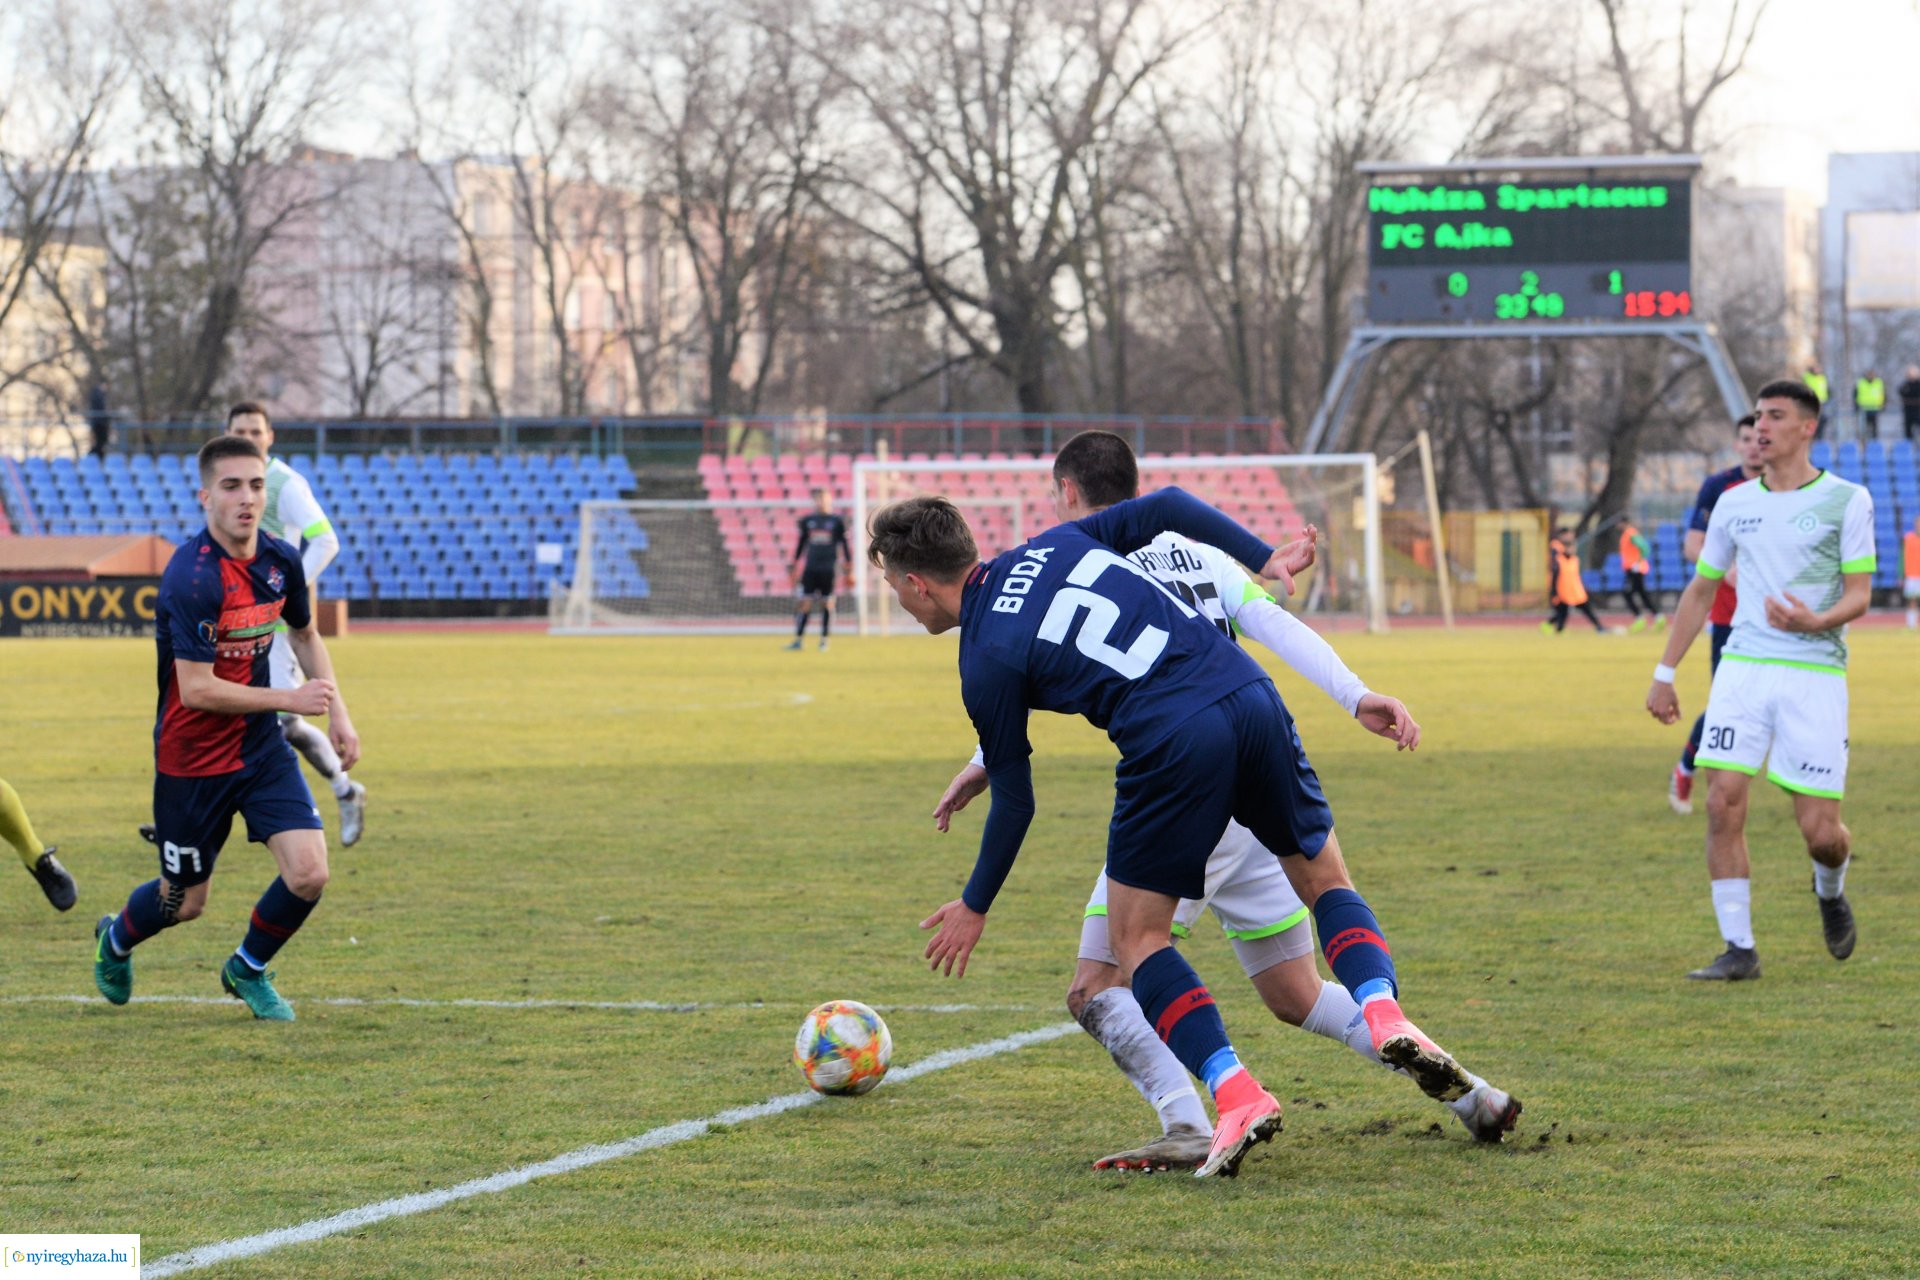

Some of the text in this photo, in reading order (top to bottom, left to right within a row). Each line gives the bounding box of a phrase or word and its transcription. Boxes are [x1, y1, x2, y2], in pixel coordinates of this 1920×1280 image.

[1497, 183, 1668, 212] Spartacus
[1381, 222, 1513, 249] FC Ajka
[1448, 272, 1468, 297] 0
[1520, 270, 1540, 296] 2
[1608, 270, 1623, 295] 1
[992, 547, 1055, 614] BODA
[10, 585, 125, 620] ONYX
[1036, 548, 1199, 681] 27
[1708, 726, 1735, 751] 30
[1801, 762, 1831, 775] Zeus
[163, 840, 202, 875] 97
